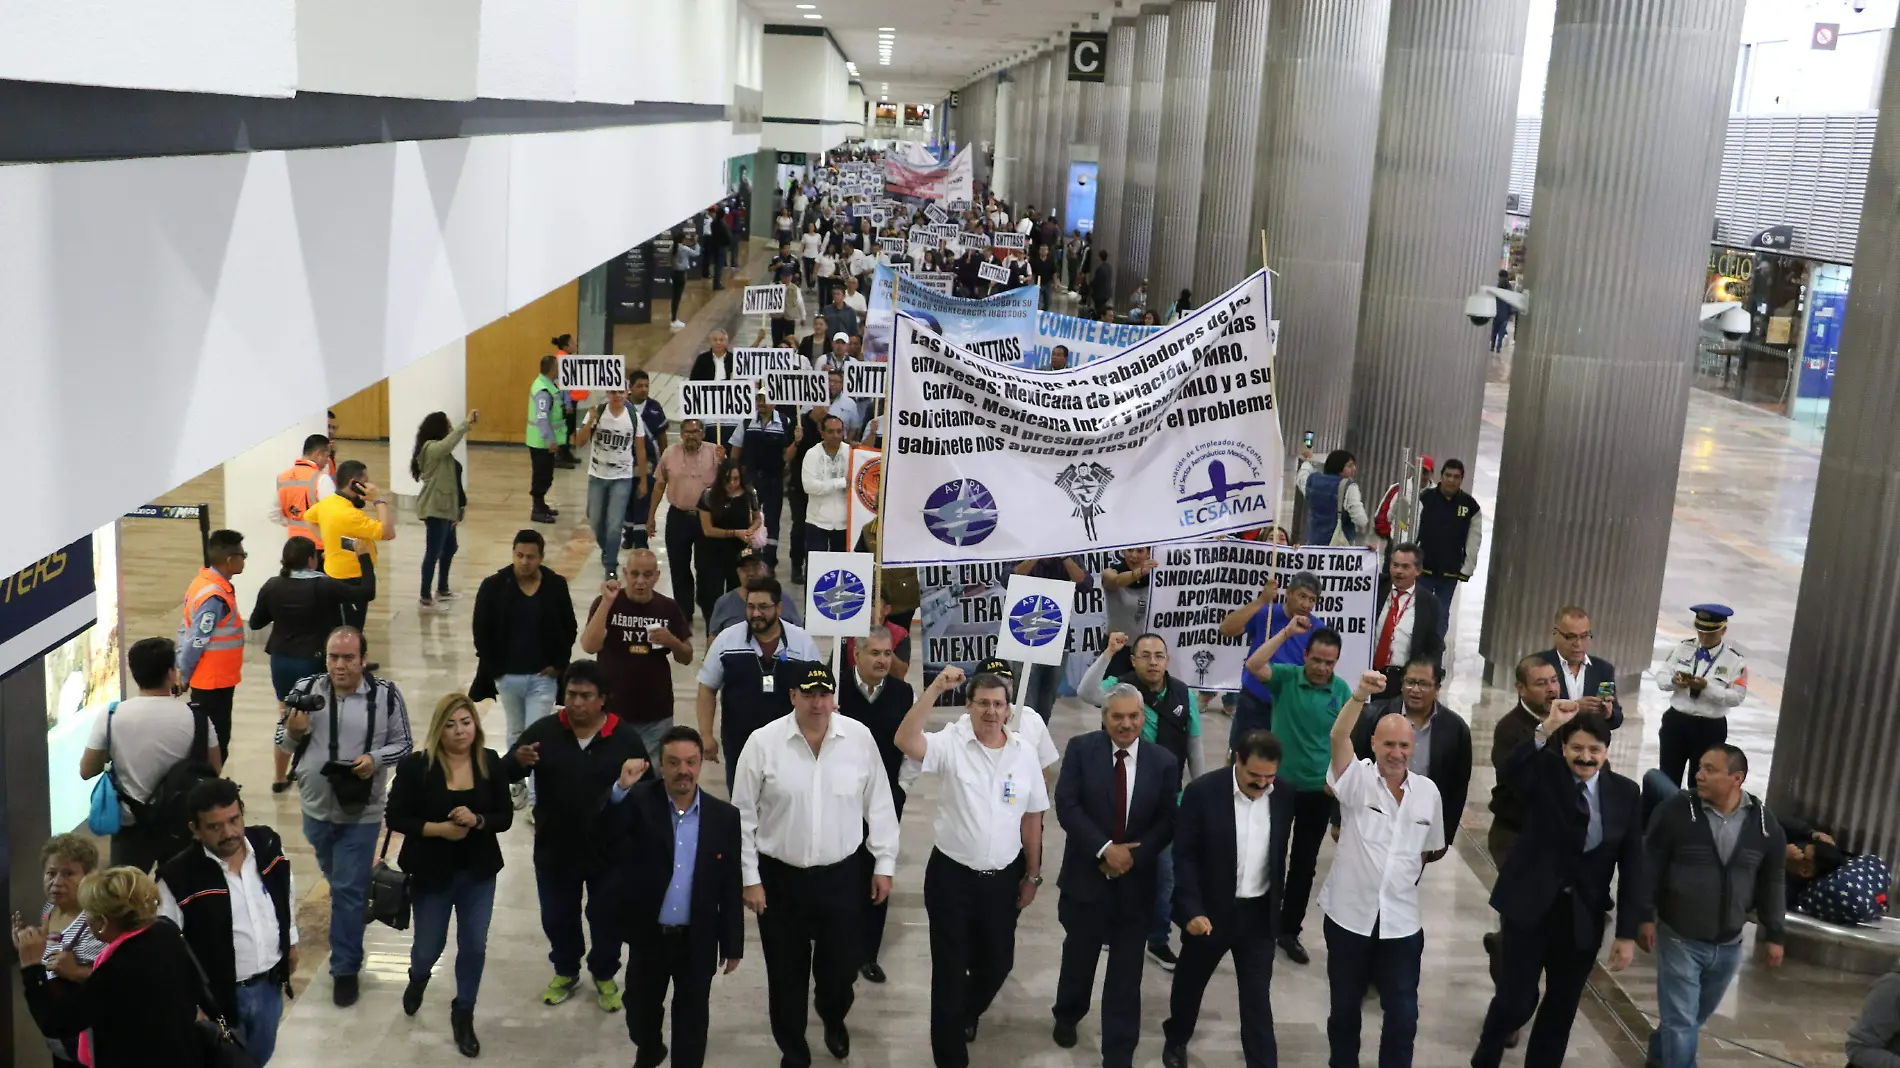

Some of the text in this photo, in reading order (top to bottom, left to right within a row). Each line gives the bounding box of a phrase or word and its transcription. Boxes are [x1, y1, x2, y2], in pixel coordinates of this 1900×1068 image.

[1074, 41, 1099, 72] C
[910, 231, 938, 247] SNTTTASS
[959, 233, 986, 248] SNTTTASS
[996, 233, 1024, 247] SNTTTASS
[981, 266, 1008, 281] SNTTTASS
[745, 287, 784, 311] SNTTTASS
[911, 329, 941, 353] Las
[1092, 328, 1205, 387] trabajadores
[1207, 309, 1228, 329] de
[562, 359, 622, 387] SNTTTASS
[912, 356, 1001, 397] empresas:
[1005, 382, 1083, 410] Mexicana
[1086, 391, 1110, 410] de
[683, 384, 751, 415] SNTTTASS
[767, 374, 826, 403] SNTTTASS
[898, 408, 997, 429] solicitamos
[1000, 424, 1017, 437] al
[1021, 430, 1125, 446] presidente
[1220, 375, 1232, 393] y
[1235, 372, 1247, 388] a
[982, 398, 1072, 433] Mexicana
[898, 436, 973, 456] gabinete
[976, 436, 1006, 452] nos
[1009, 441, 1079, 458] ayuden
[1166, 408, 1185, 428] el
[1187, 393, 1272, 426] problema
[1195, 440, 1235, 452] Empleados
[1236, 441, 1245, 449] de
[1191, 450, 1226, 467] Aeronáutico
[1167, 546, 1363, 572] LOS TRABAJADORES DE TACA
[1155, 567, 1269, 588] SINDICALIZADOS
[1177, 587, 1253, 607] APOYAMOS
[1348, 622, 1366, 634] DE
[808, 670, 827, 678] ASPA
[987, 661, 1003, 670] ASPA
